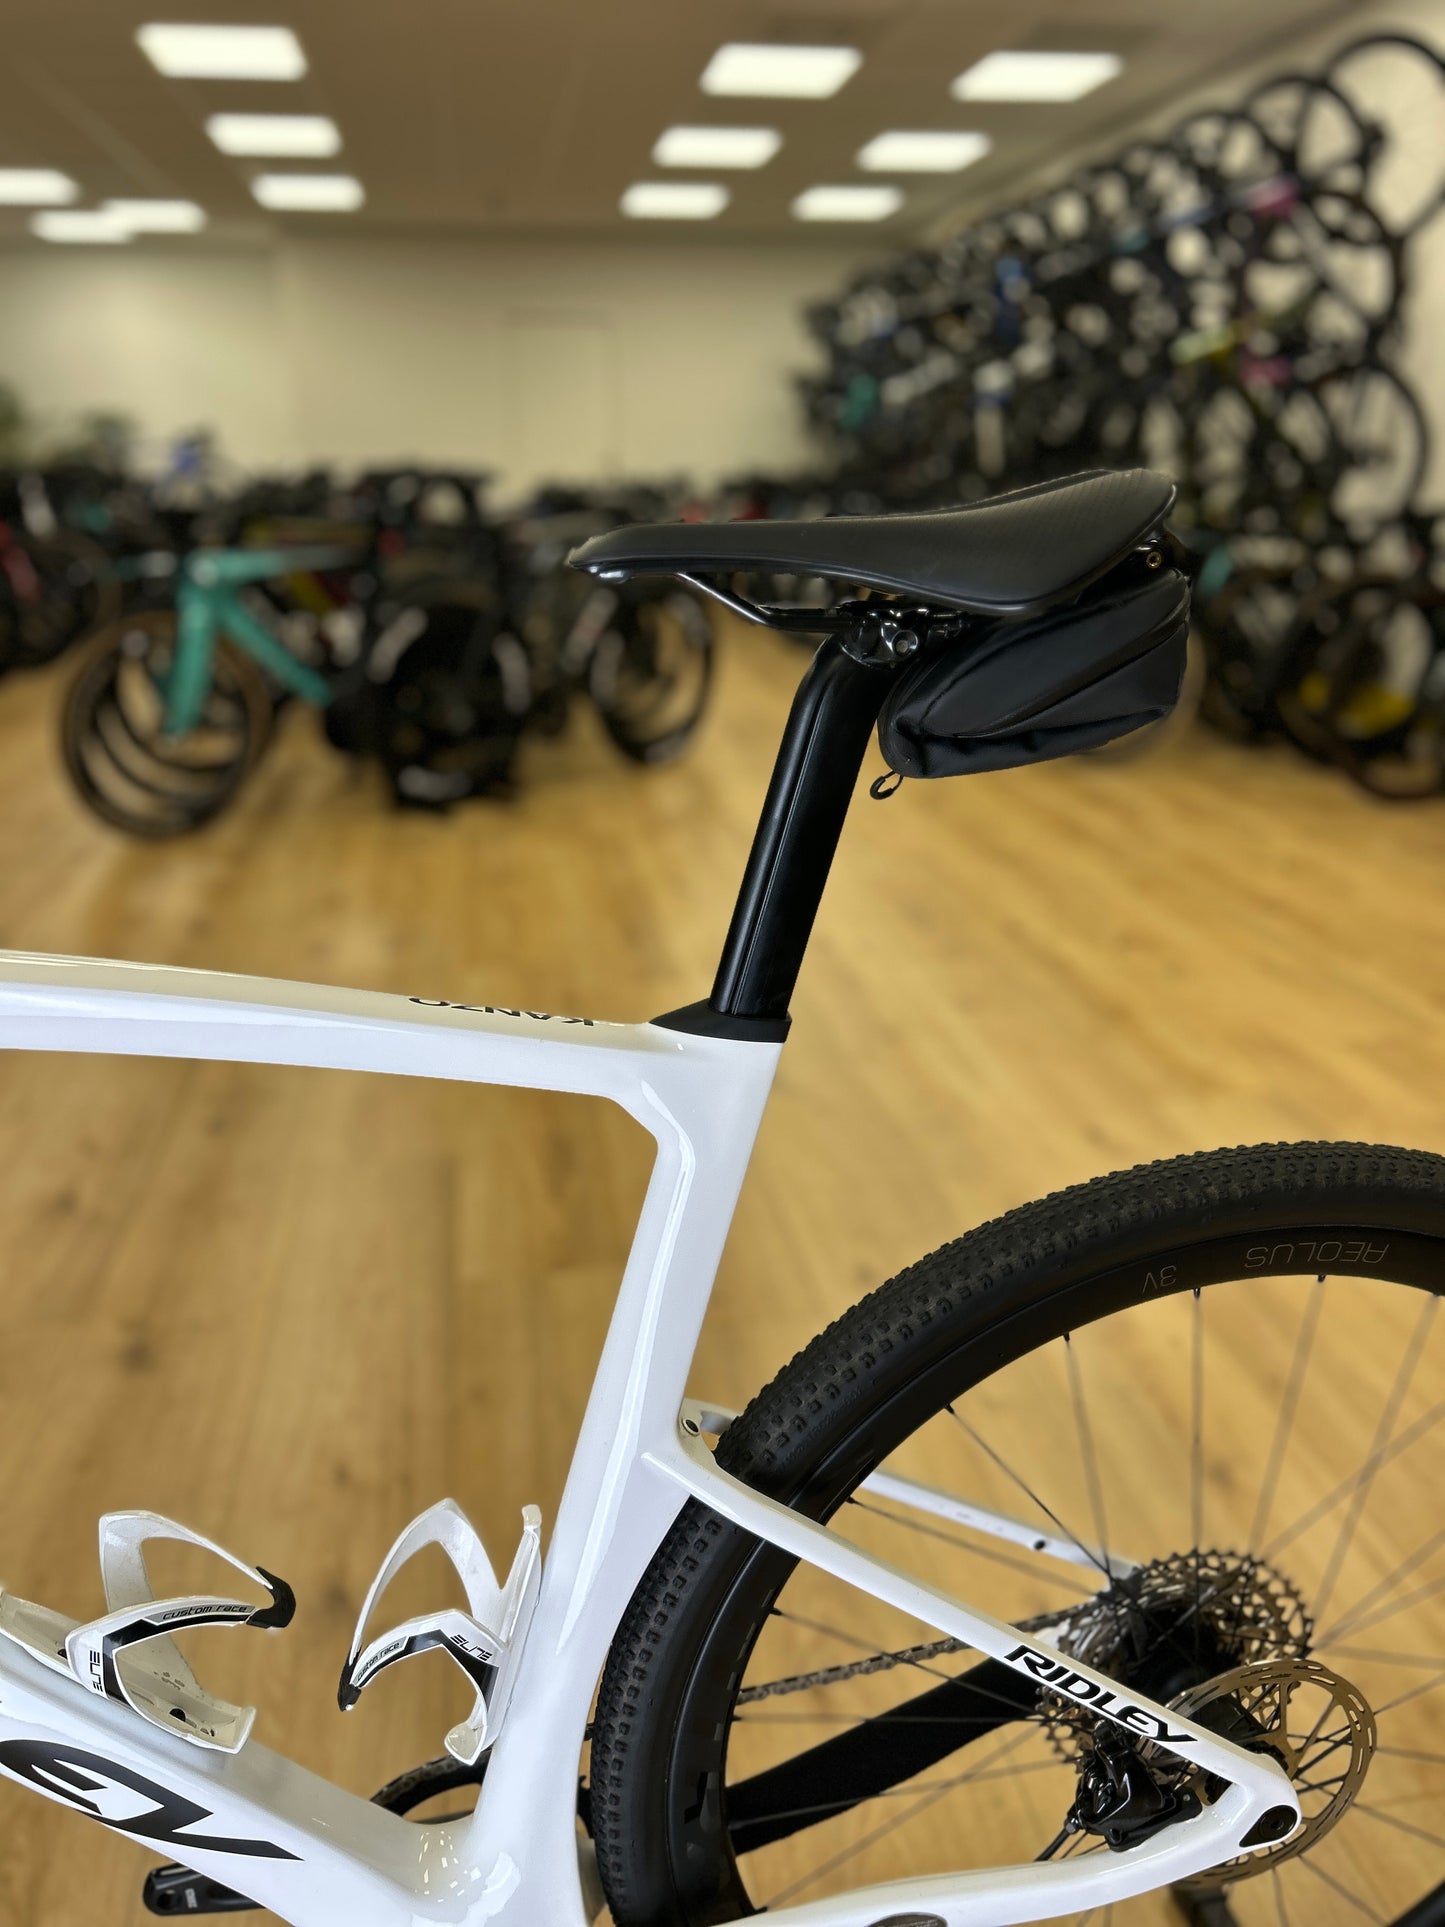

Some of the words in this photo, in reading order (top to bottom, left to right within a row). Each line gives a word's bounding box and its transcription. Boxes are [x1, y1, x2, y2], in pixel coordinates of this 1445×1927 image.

[1244, 1241, 1389, 1268] AEOLUS
[1142, 1265, 1176, 1293] 3V
[163, 1606, 213, 1620] custom
[216, 1605, 248, 1613] race
[450, 1634, 493, 1661] ELITE
[1004, 1644, 1198, 1742] RIDLEY
